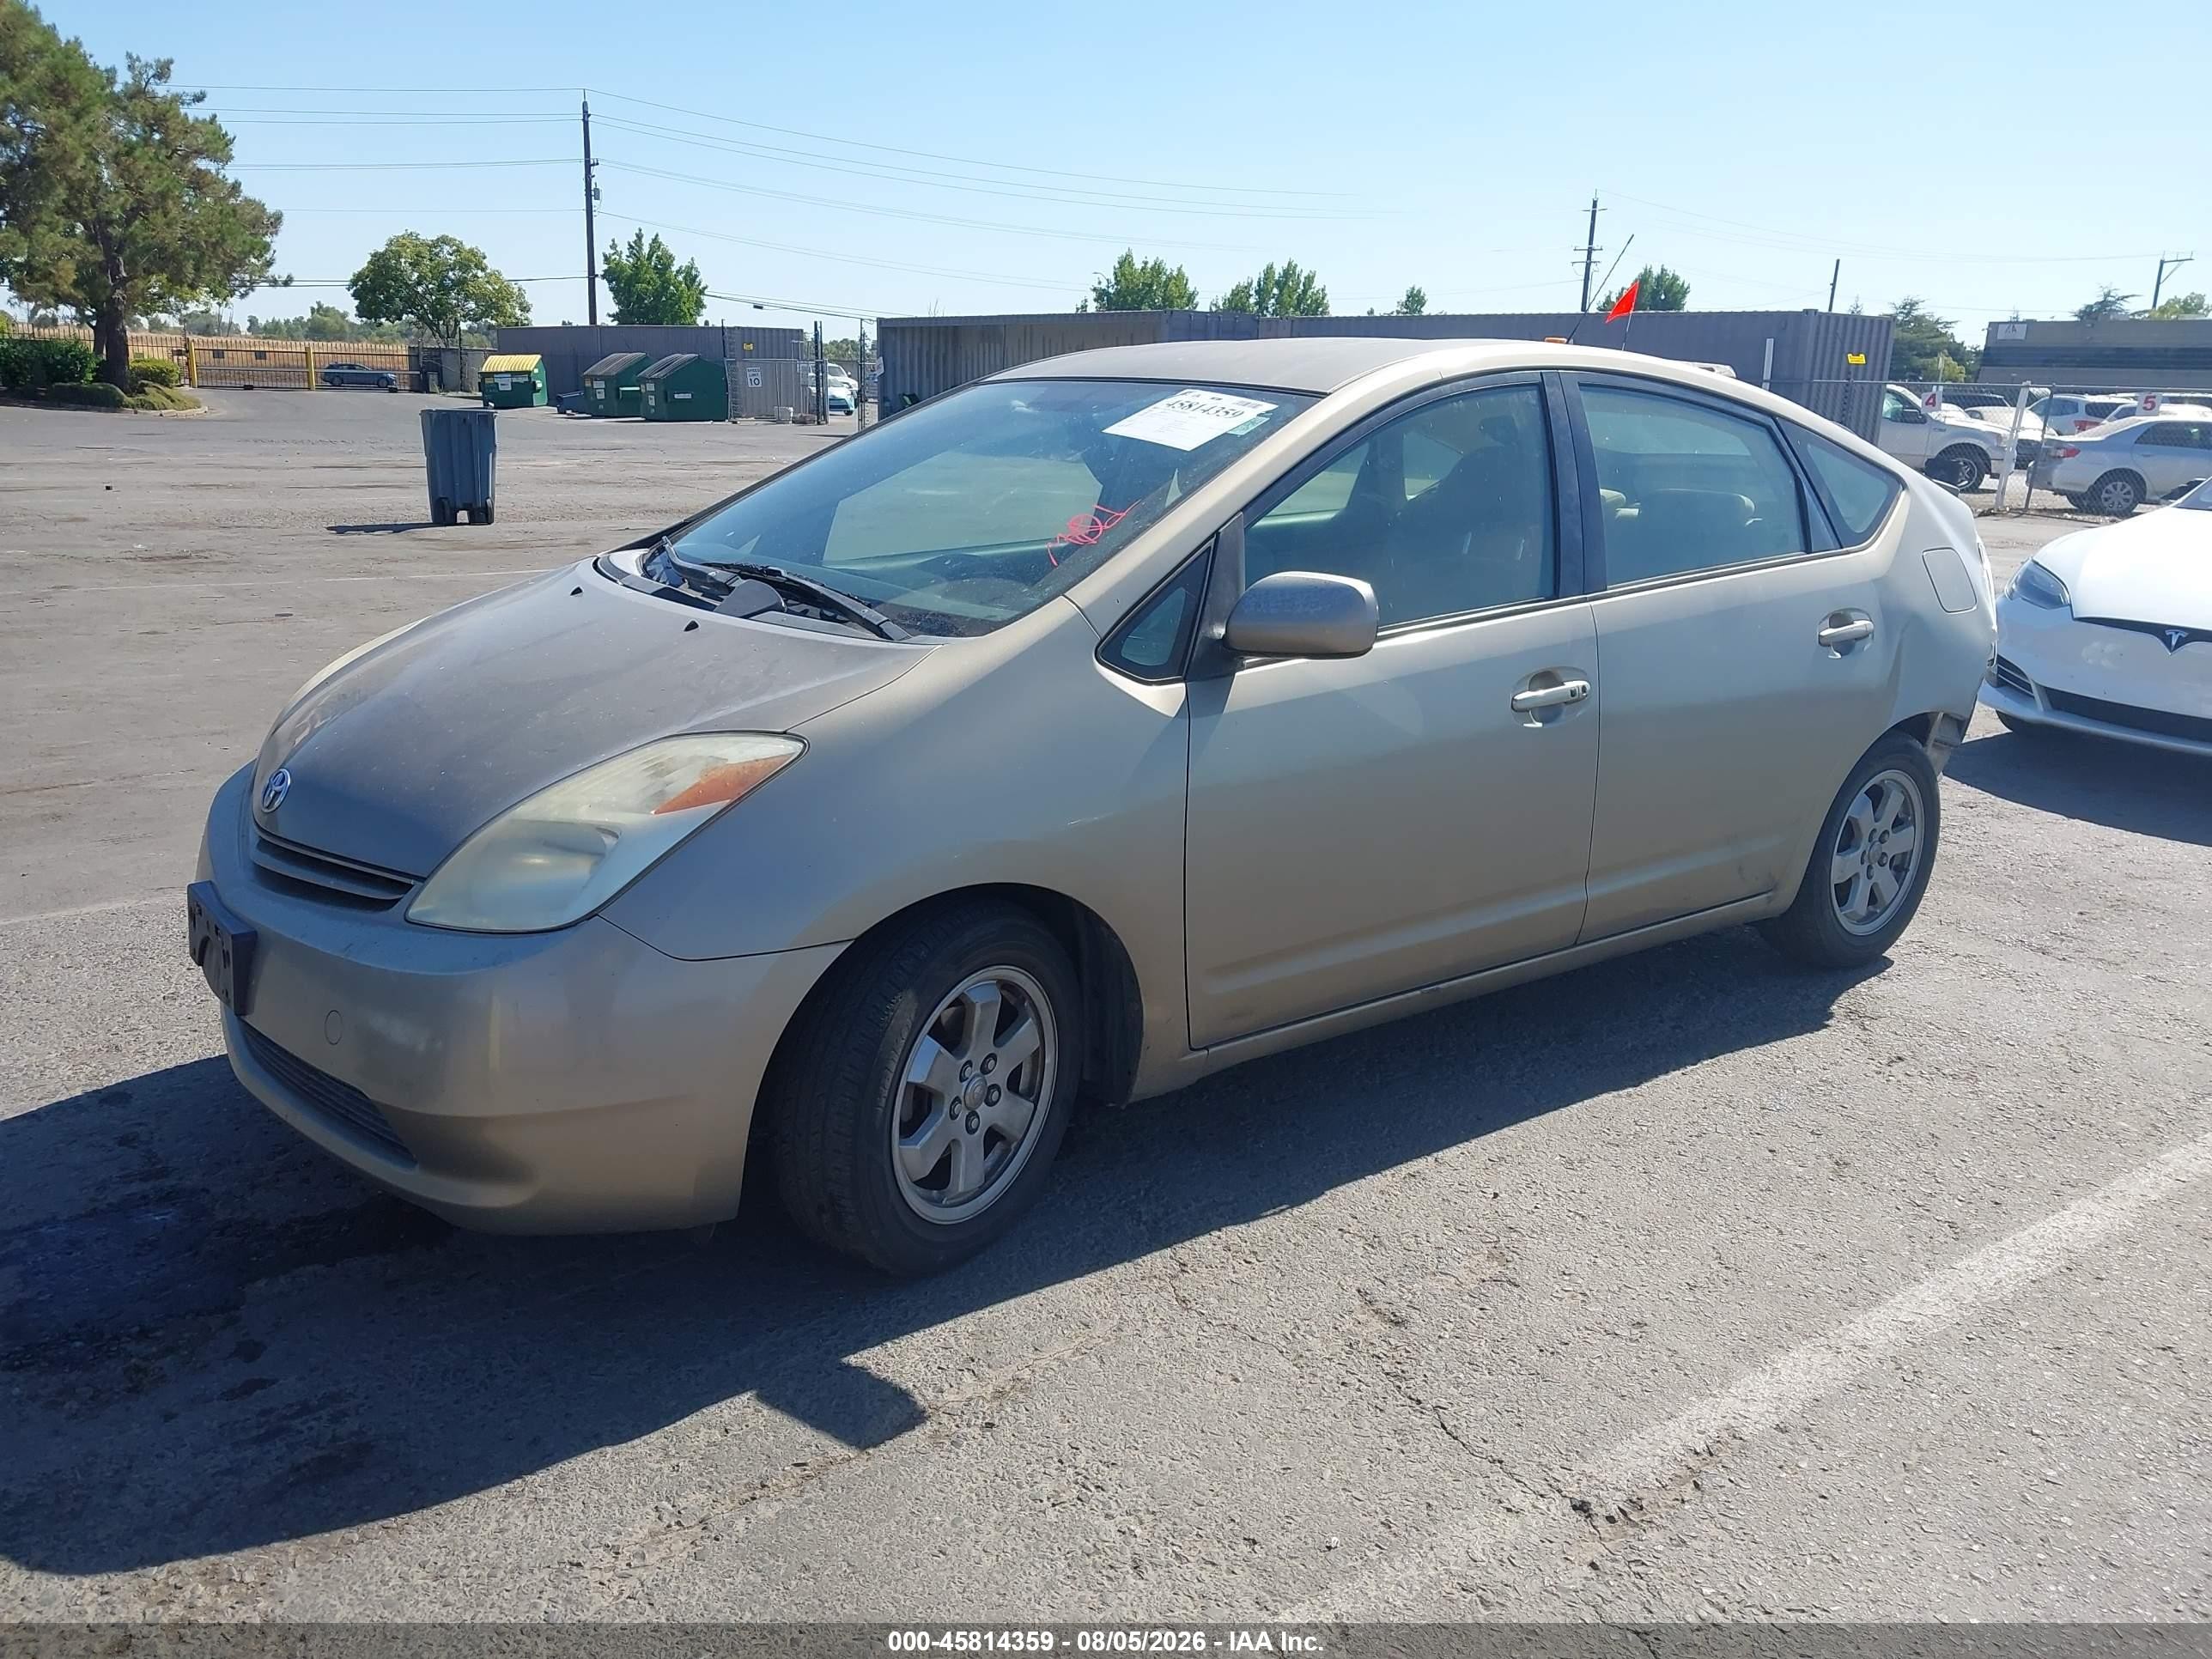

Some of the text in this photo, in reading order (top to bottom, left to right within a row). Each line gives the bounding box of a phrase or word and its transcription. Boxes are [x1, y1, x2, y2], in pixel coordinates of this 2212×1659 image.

[749, 377, 760, 386] 10
[1925, 393, 1936, 407] 4
[2142, 395, 2156, 410] 5
[1166, 400, 1245, 419] 45814359
